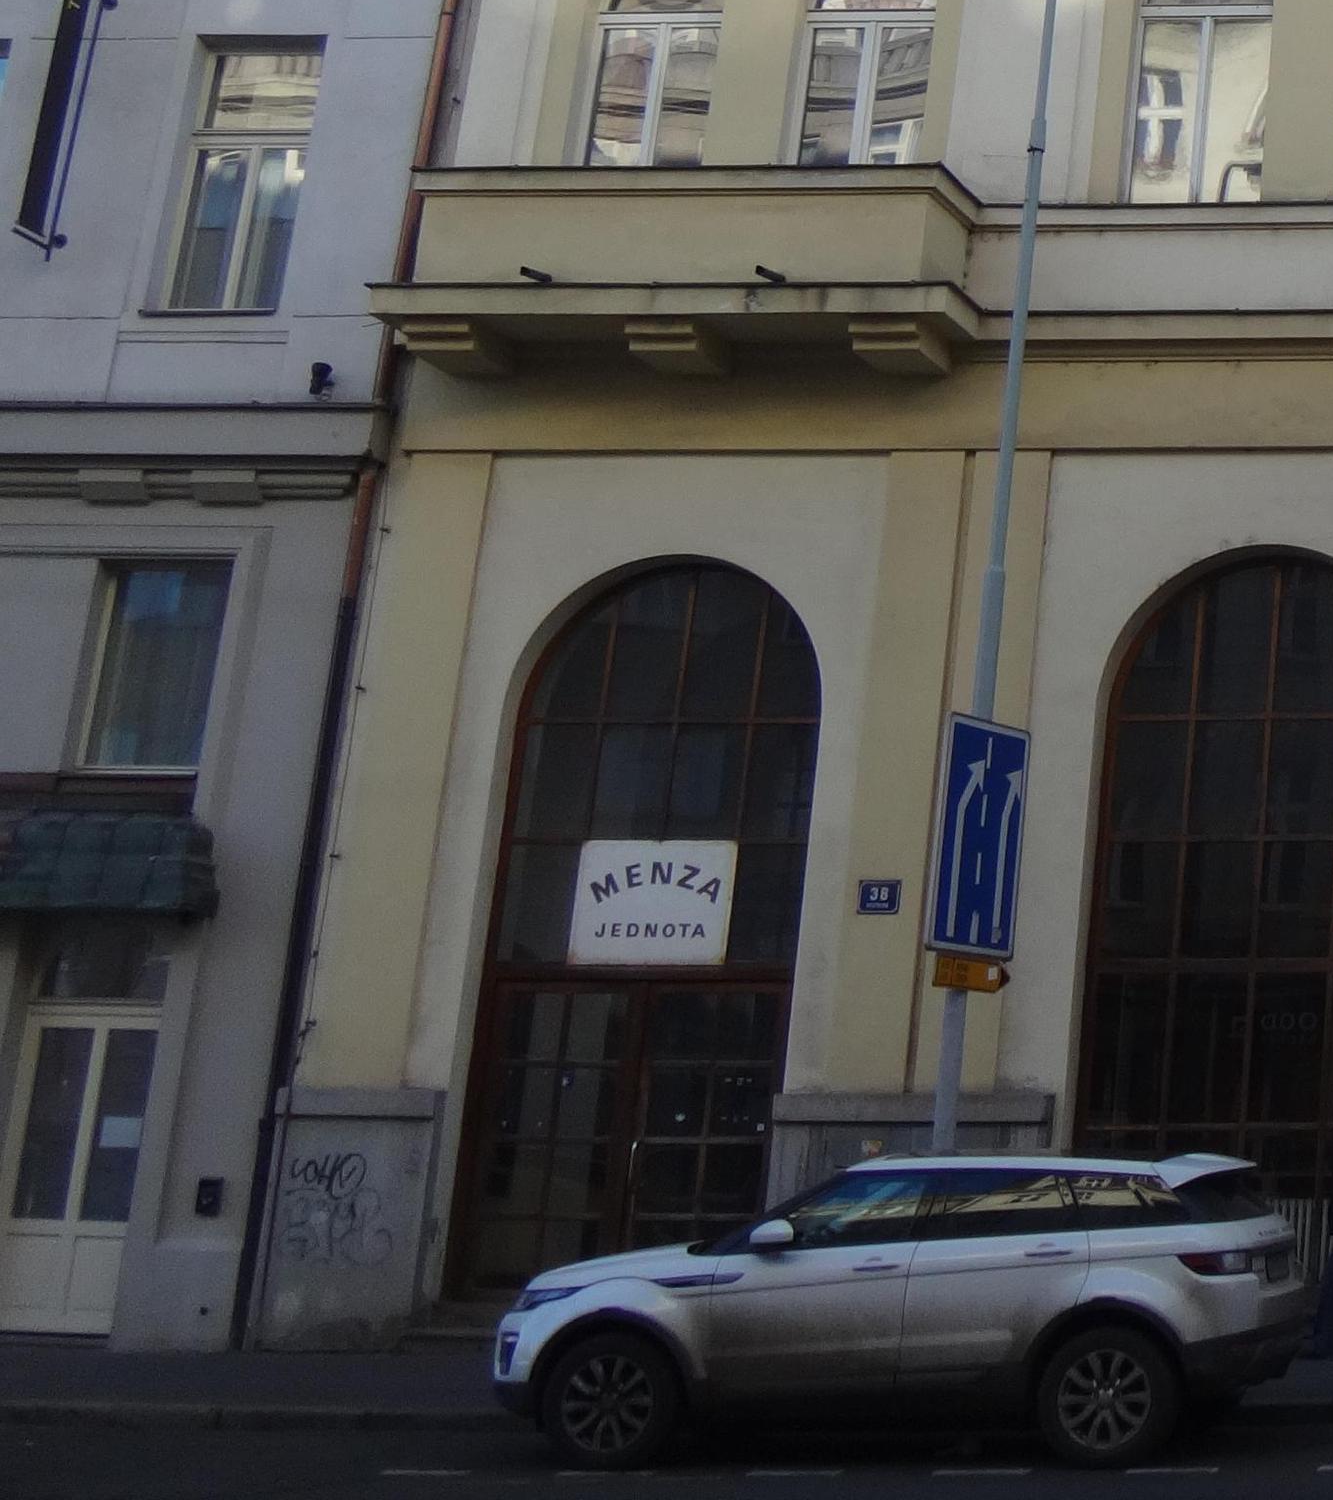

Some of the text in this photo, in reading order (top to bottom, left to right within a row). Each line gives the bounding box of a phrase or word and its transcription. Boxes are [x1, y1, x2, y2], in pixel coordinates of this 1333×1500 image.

[590, 861, 722, 904] MENZA
[869, 886, 889, 901] 38
[594, 922, 706, 938] JEDNOTA
